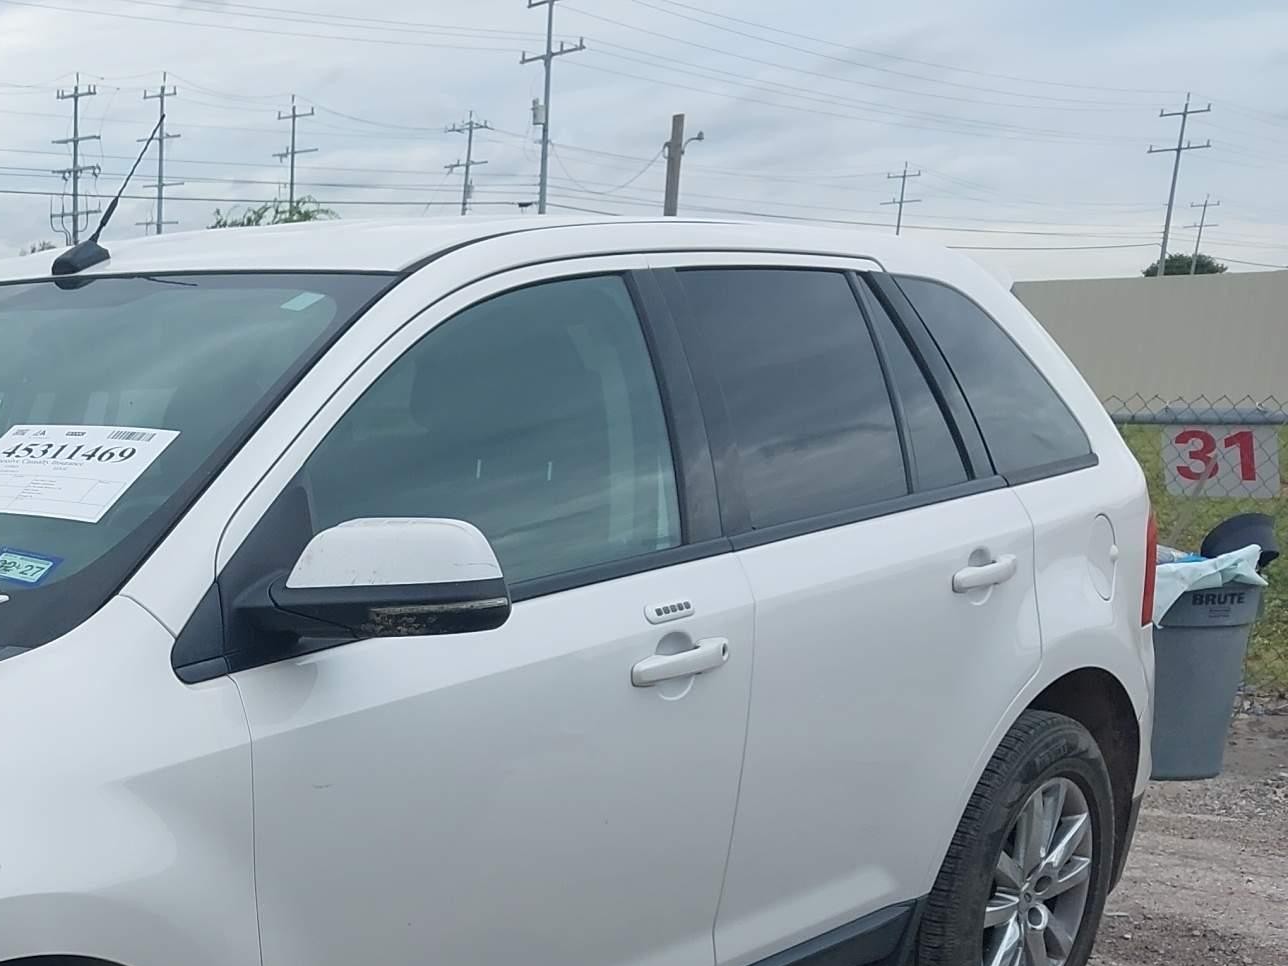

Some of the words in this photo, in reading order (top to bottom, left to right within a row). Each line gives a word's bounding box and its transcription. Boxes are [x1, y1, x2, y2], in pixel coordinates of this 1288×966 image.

[2, 443, 137, 463] 45311469
[1174, 430, 1257, 481] 31
[1191, 592, 1246, 606] BRUTE
